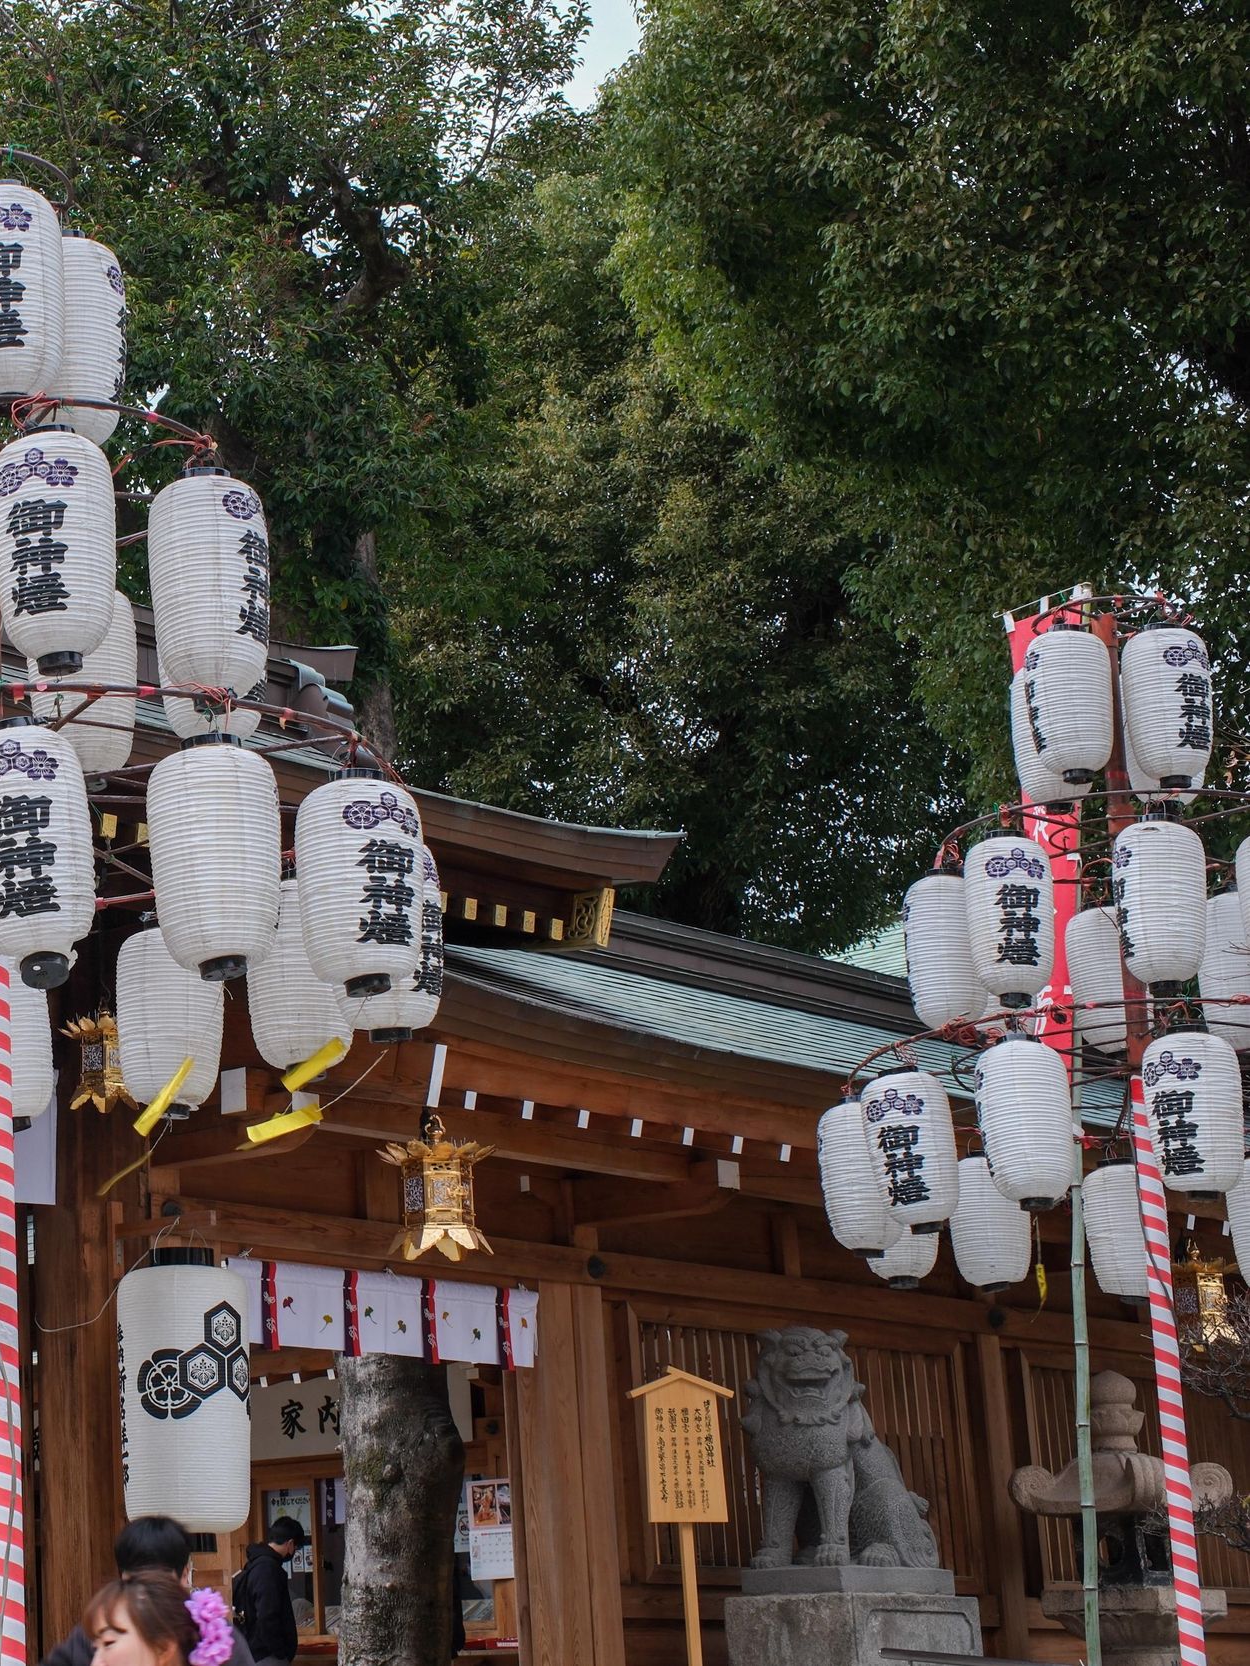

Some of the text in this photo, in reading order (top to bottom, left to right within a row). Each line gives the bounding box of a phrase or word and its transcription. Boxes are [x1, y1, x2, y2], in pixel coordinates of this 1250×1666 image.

[6, 498, 71, 618] 御神燈
[1174, 673, 1212, 752] 御神燈
[355, 838, 416, 947] 御神燈
[993, 883, 1042, 967] 御神燈
[876, 1125, 932, 1207] 御神燈
[1151, 1090, 1206, 1177] 御神燈
